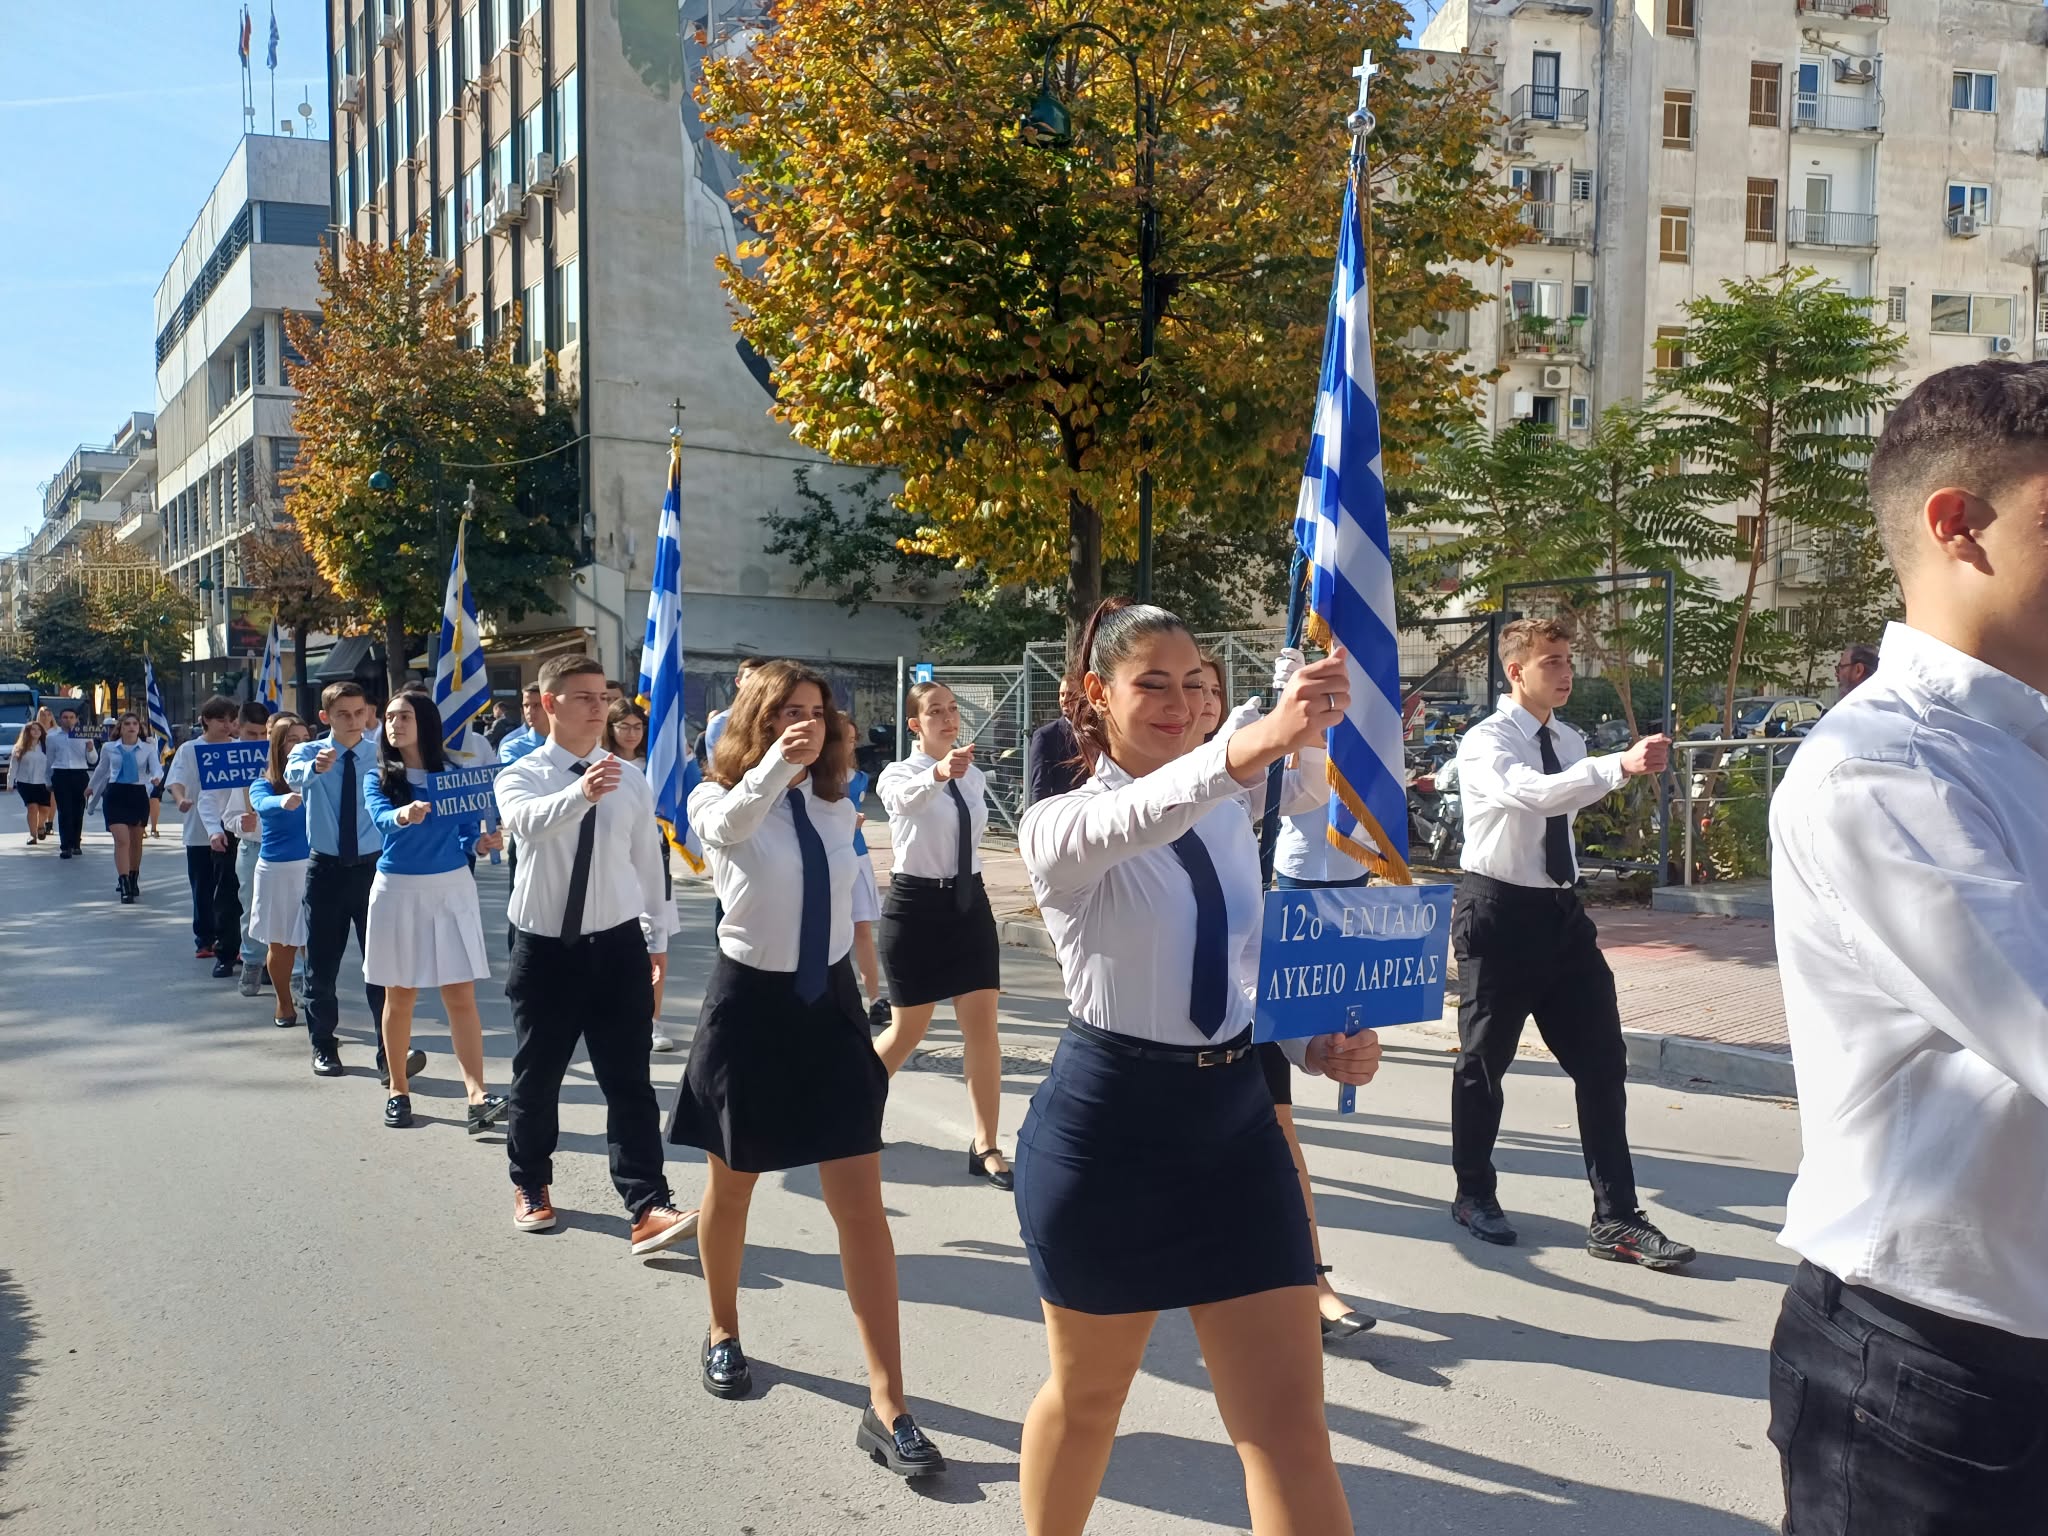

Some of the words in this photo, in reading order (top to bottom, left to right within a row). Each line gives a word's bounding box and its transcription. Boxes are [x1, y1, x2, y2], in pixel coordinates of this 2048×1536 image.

[1340, 903, 1437, 938] ΕΝΙΑΙΟ
[1267, 963, 1346, 1000] ΛΥΚΕΙΟ
[1354, 955, 1439, 992] ΛΑΡΙΣΑΣ
